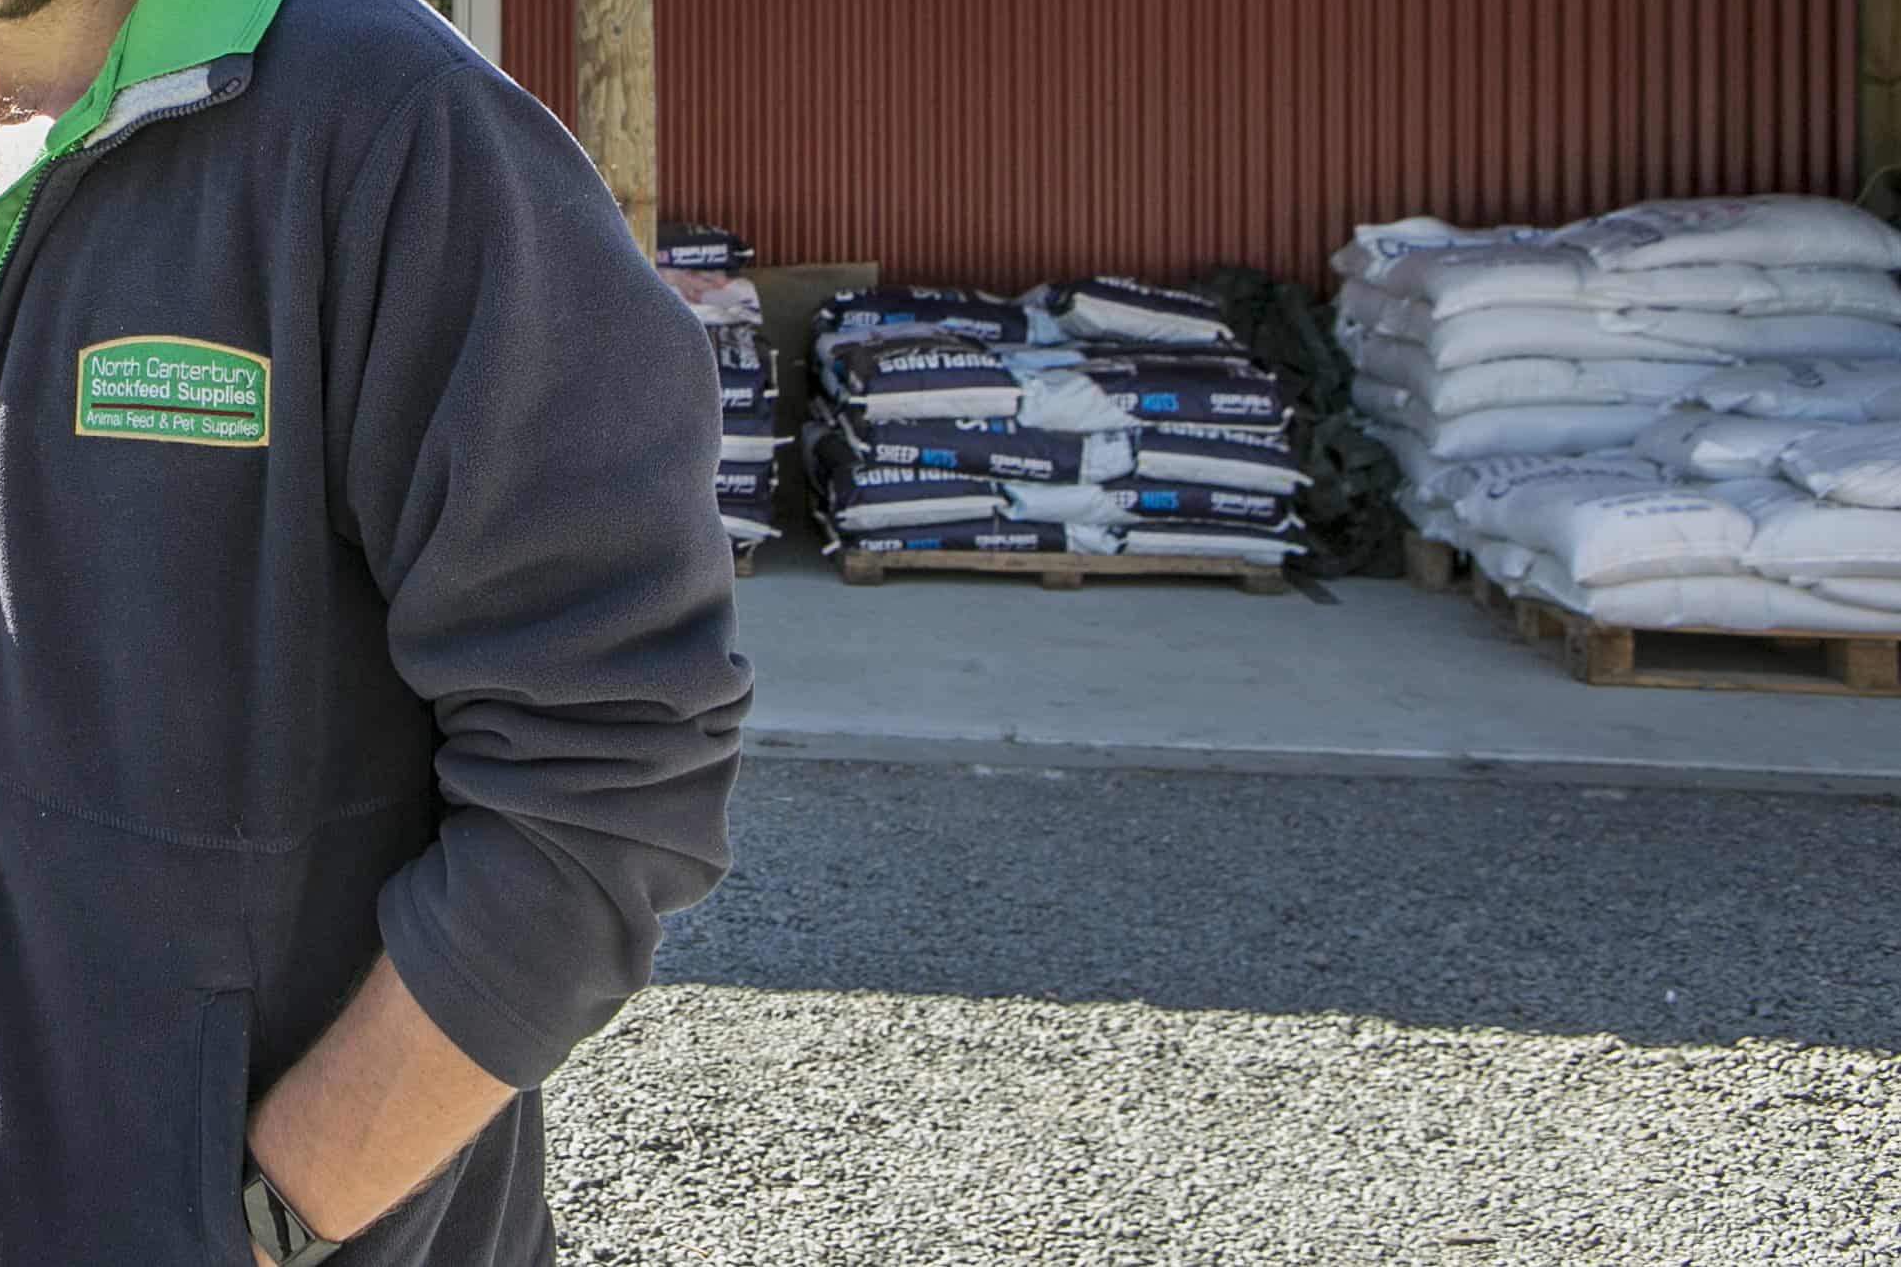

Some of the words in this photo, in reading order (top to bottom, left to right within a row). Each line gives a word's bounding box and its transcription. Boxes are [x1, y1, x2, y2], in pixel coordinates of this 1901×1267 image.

[91, 356, 140, 377] North
[146, 357, 257, 388] Canterbury
[91, 378, 170, 399] Stockfeed
[178, 382, 256, 407] Supplies
[86, 412, 123, 427] Animal
[126, 412, 154, 428] Feed
[159, 415, 169, 429] &
[173, 416, 195, 431] Pet
[202, 419, 259, 437] Supplies
[875, 444, 919, 464] SHEEP
